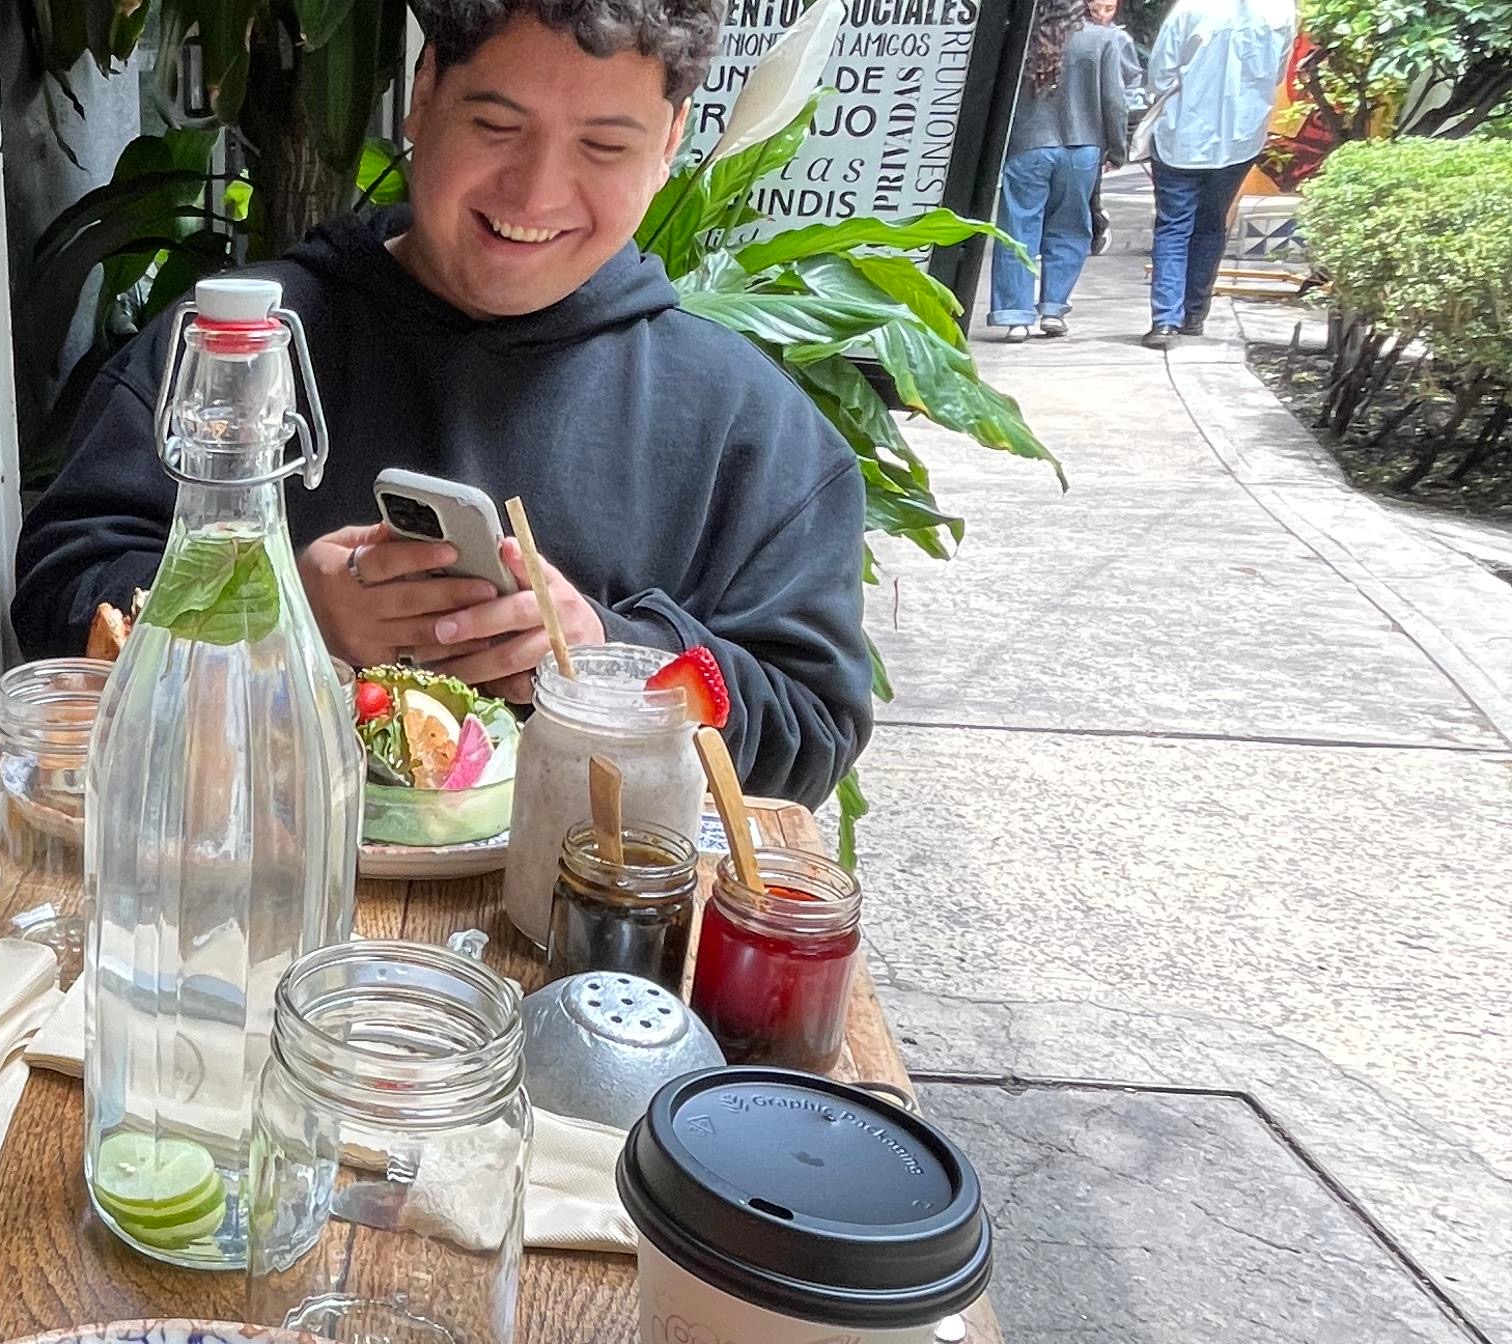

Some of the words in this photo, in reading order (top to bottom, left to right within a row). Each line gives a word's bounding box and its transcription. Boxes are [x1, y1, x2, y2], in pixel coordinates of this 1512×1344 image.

[849, 32, 931, 57] AMIGOS
[837, 66, 886, 94] DE
[915, 30, 976, 194] REUNIONES
[872, 66, 925, 211] PRIVADAS
[750, 187, 857, 219] INDIS
[751, 1094, 837, 1118] Graphic
